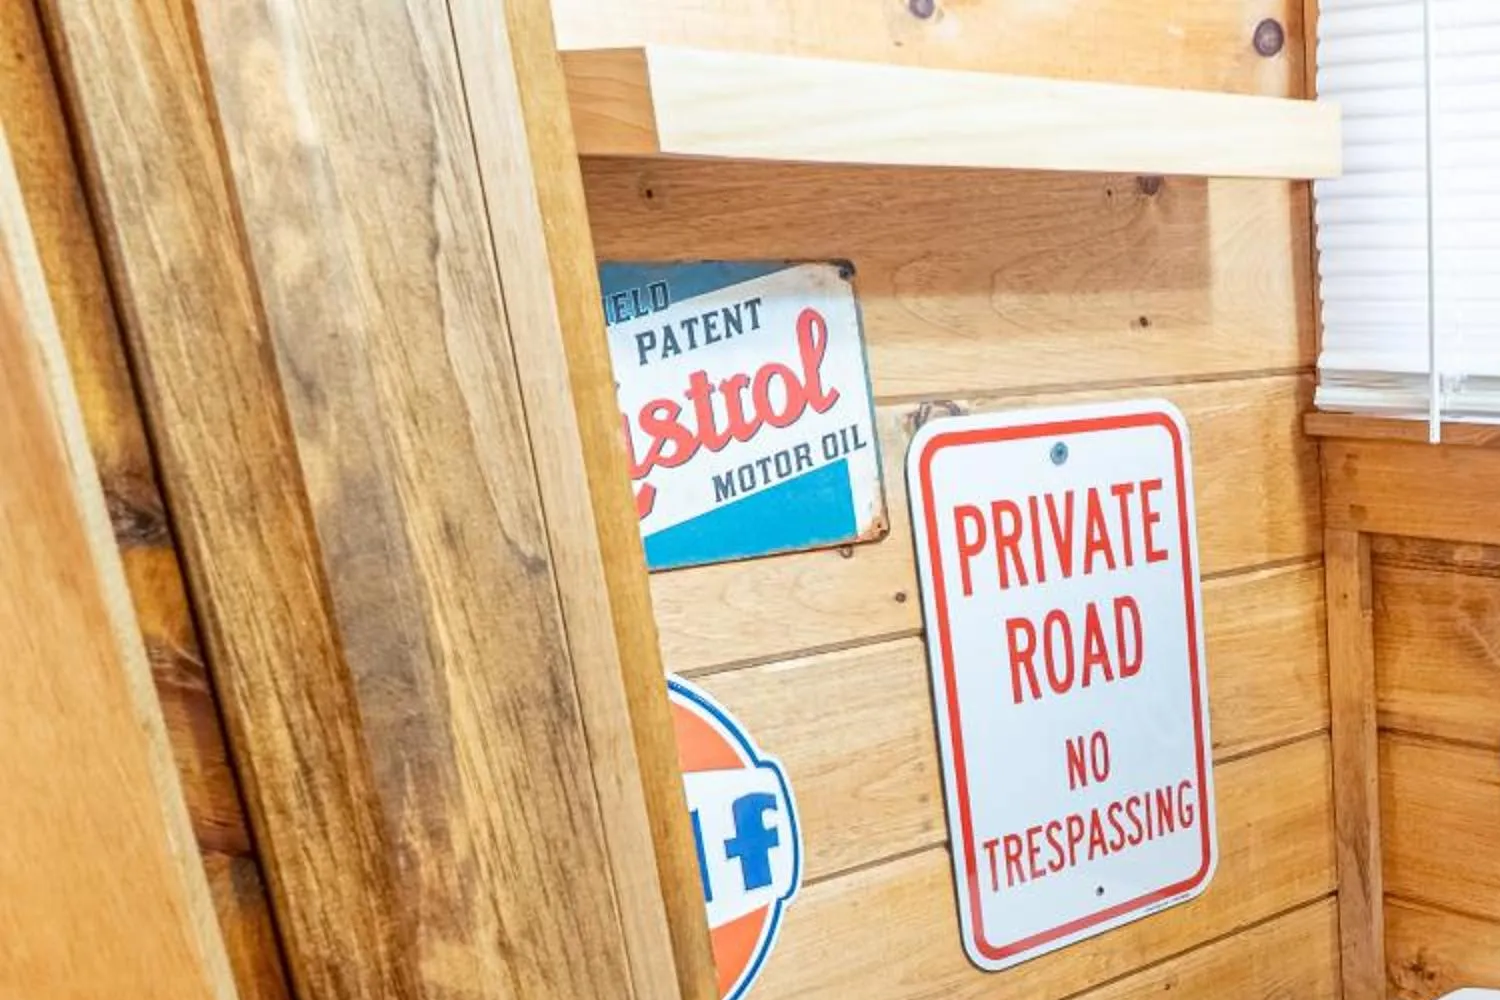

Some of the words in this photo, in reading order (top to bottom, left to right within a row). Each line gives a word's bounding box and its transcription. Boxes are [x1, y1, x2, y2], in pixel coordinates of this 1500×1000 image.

[602, 280, 670, 327] ELD
[635, 298, 762, 366] PATENT
[618, 307, 841, 484] strol
[712, 442, 814, 502] MOTOR
[822, 424, 867, 461] OIL
[953, 478, 1169, 597] PRIVATE
[1005, 595, 1144, 704] ROAD
[1065, 730, 1111, 790] NO
[983, 779, 1194, 892] TRESPASSING
